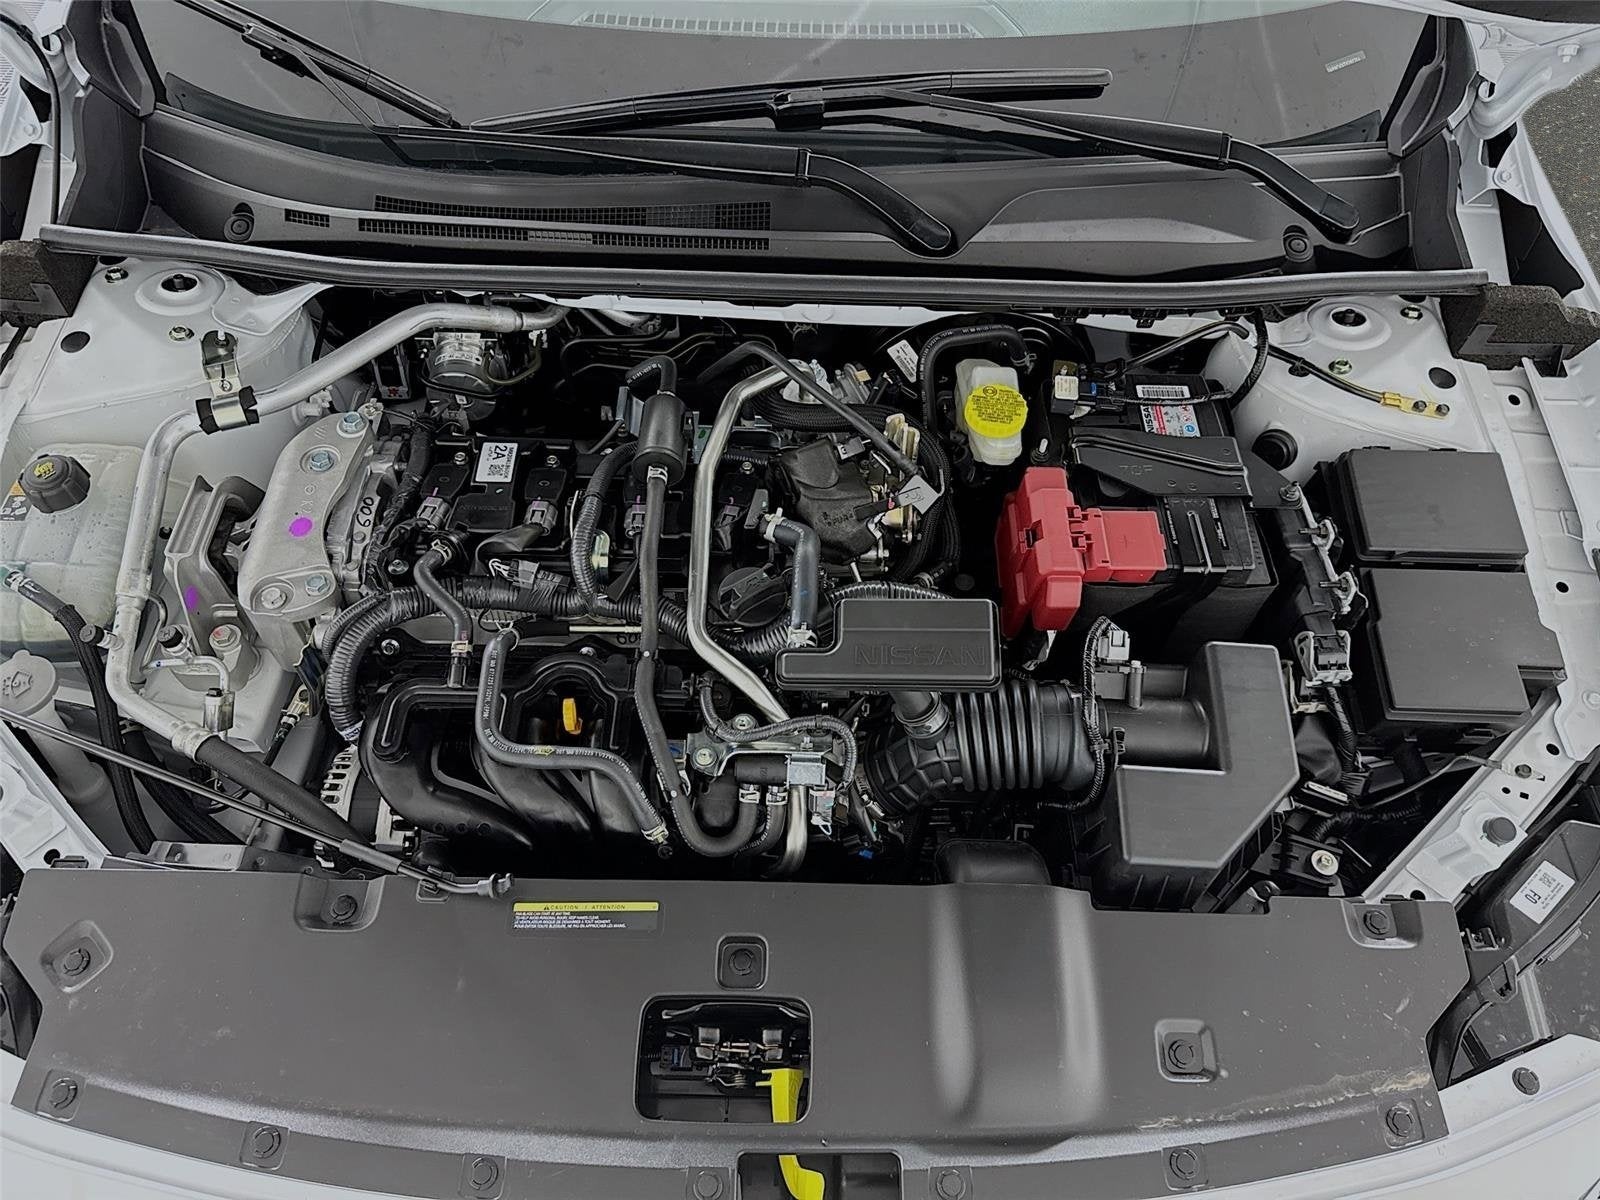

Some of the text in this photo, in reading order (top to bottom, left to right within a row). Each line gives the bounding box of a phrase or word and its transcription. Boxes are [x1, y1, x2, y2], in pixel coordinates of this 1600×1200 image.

[1142, 404, 1155, 433] NISSA
[492, 445, 508, 460] 2A
[855, 646, 985, 666] NISSAN
